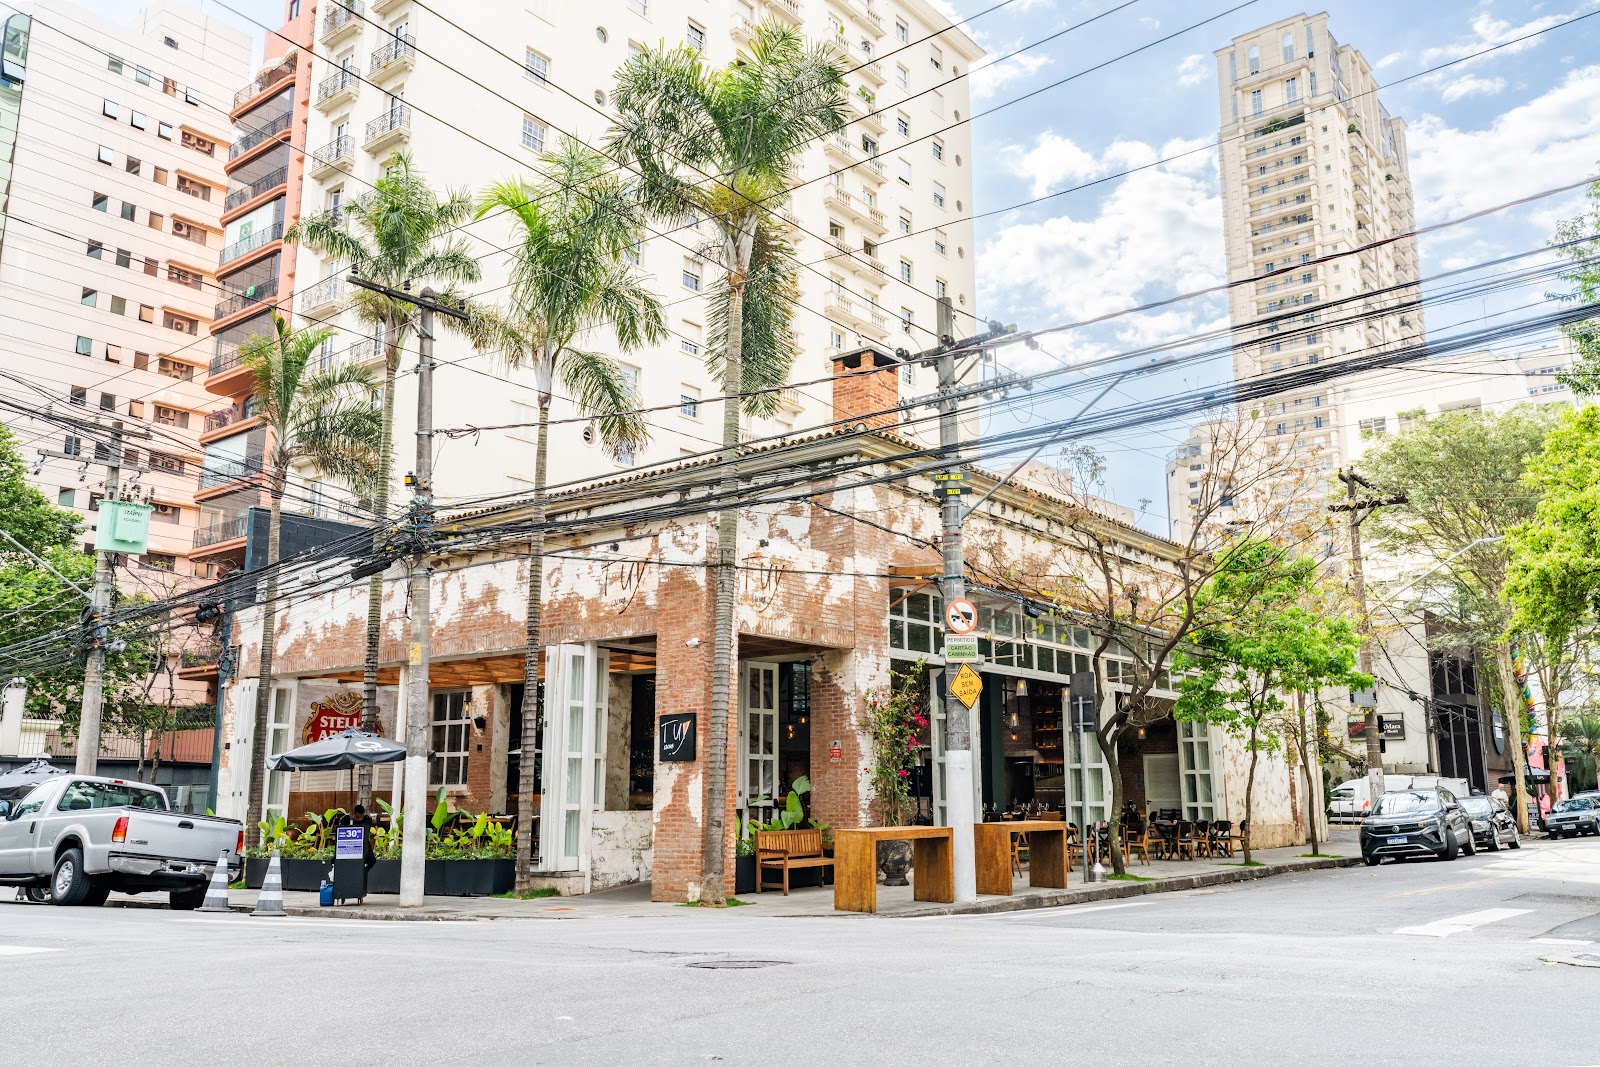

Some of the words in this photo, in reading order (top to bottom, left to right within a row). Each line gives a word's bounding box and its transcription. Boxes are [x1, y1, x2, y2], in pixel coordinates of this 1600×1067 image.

[960, 672, 973, 680] RUA
[959, 688, 977, 697] SAÍDA
[320, 715, 363, 729] STELL
